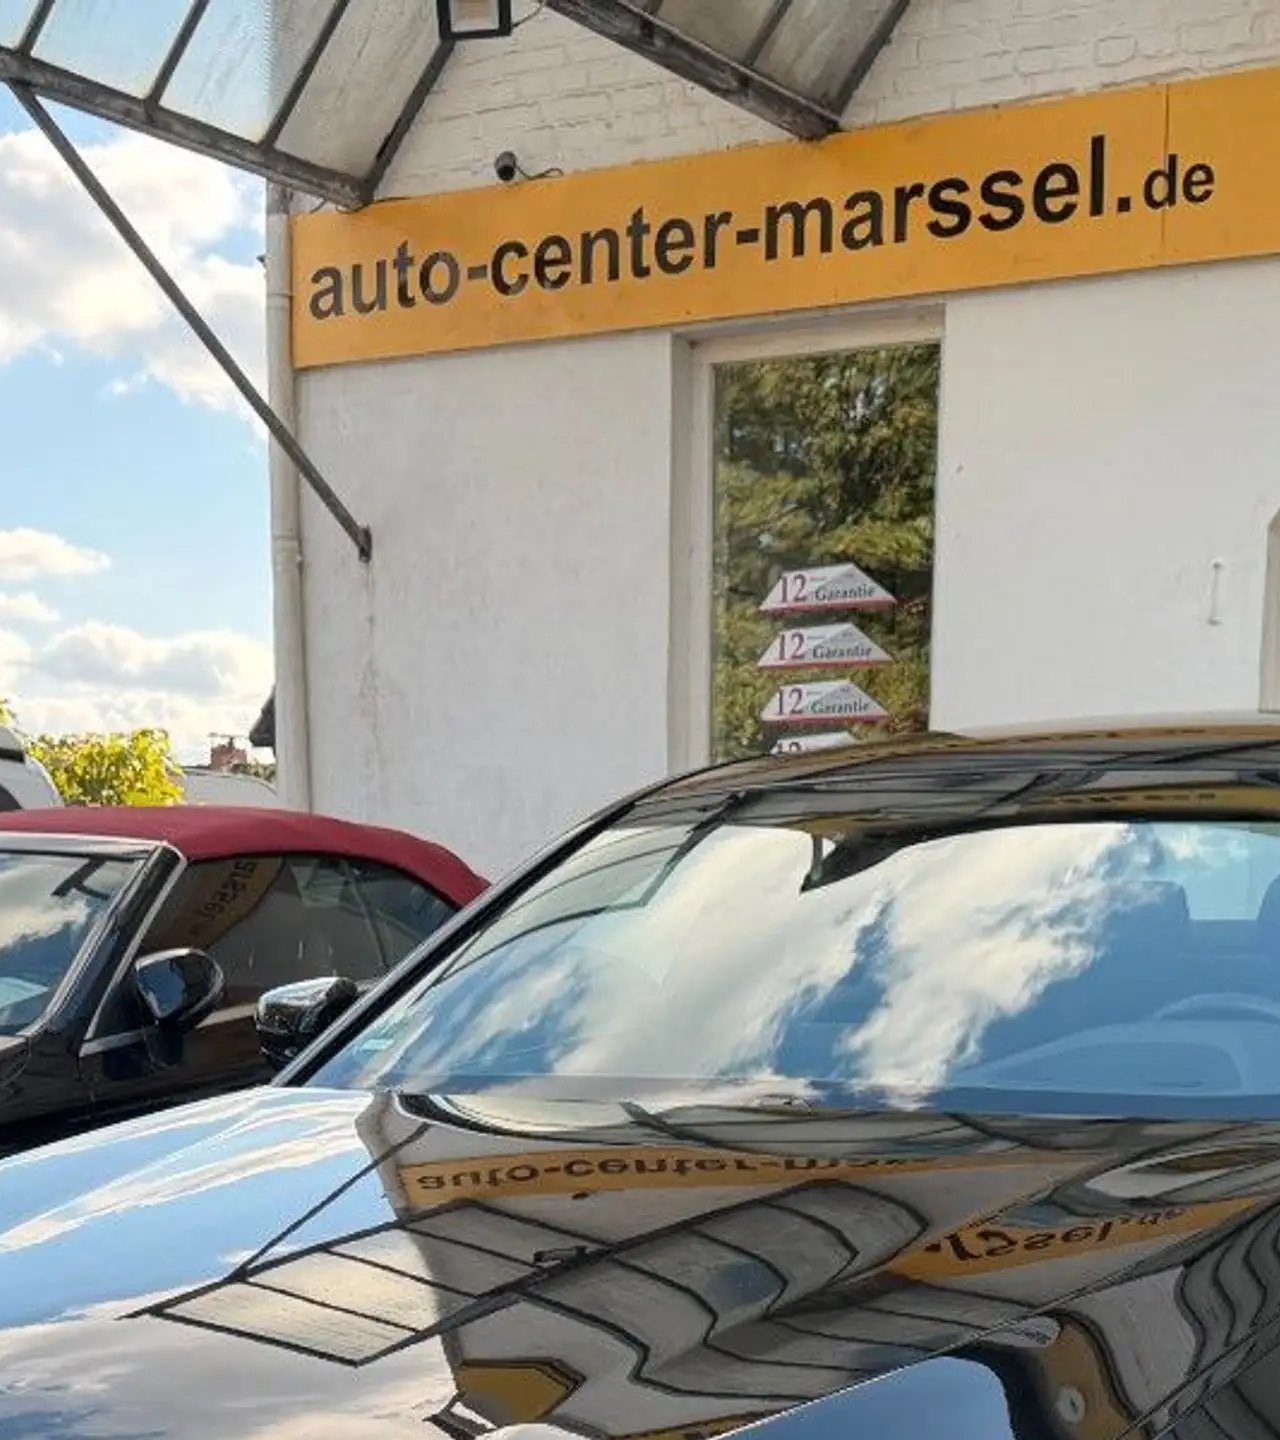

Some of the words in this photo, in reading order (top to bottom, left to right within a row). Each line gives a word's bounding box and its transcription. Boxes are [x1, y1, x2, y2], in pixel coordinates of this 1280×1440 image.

[308, 135, 1216, 321] auto-center-marssel.de
[778, 573, 809, 604] 12
[776, 631, 807, 662] 12
[775, 688, 806, 717] 12
